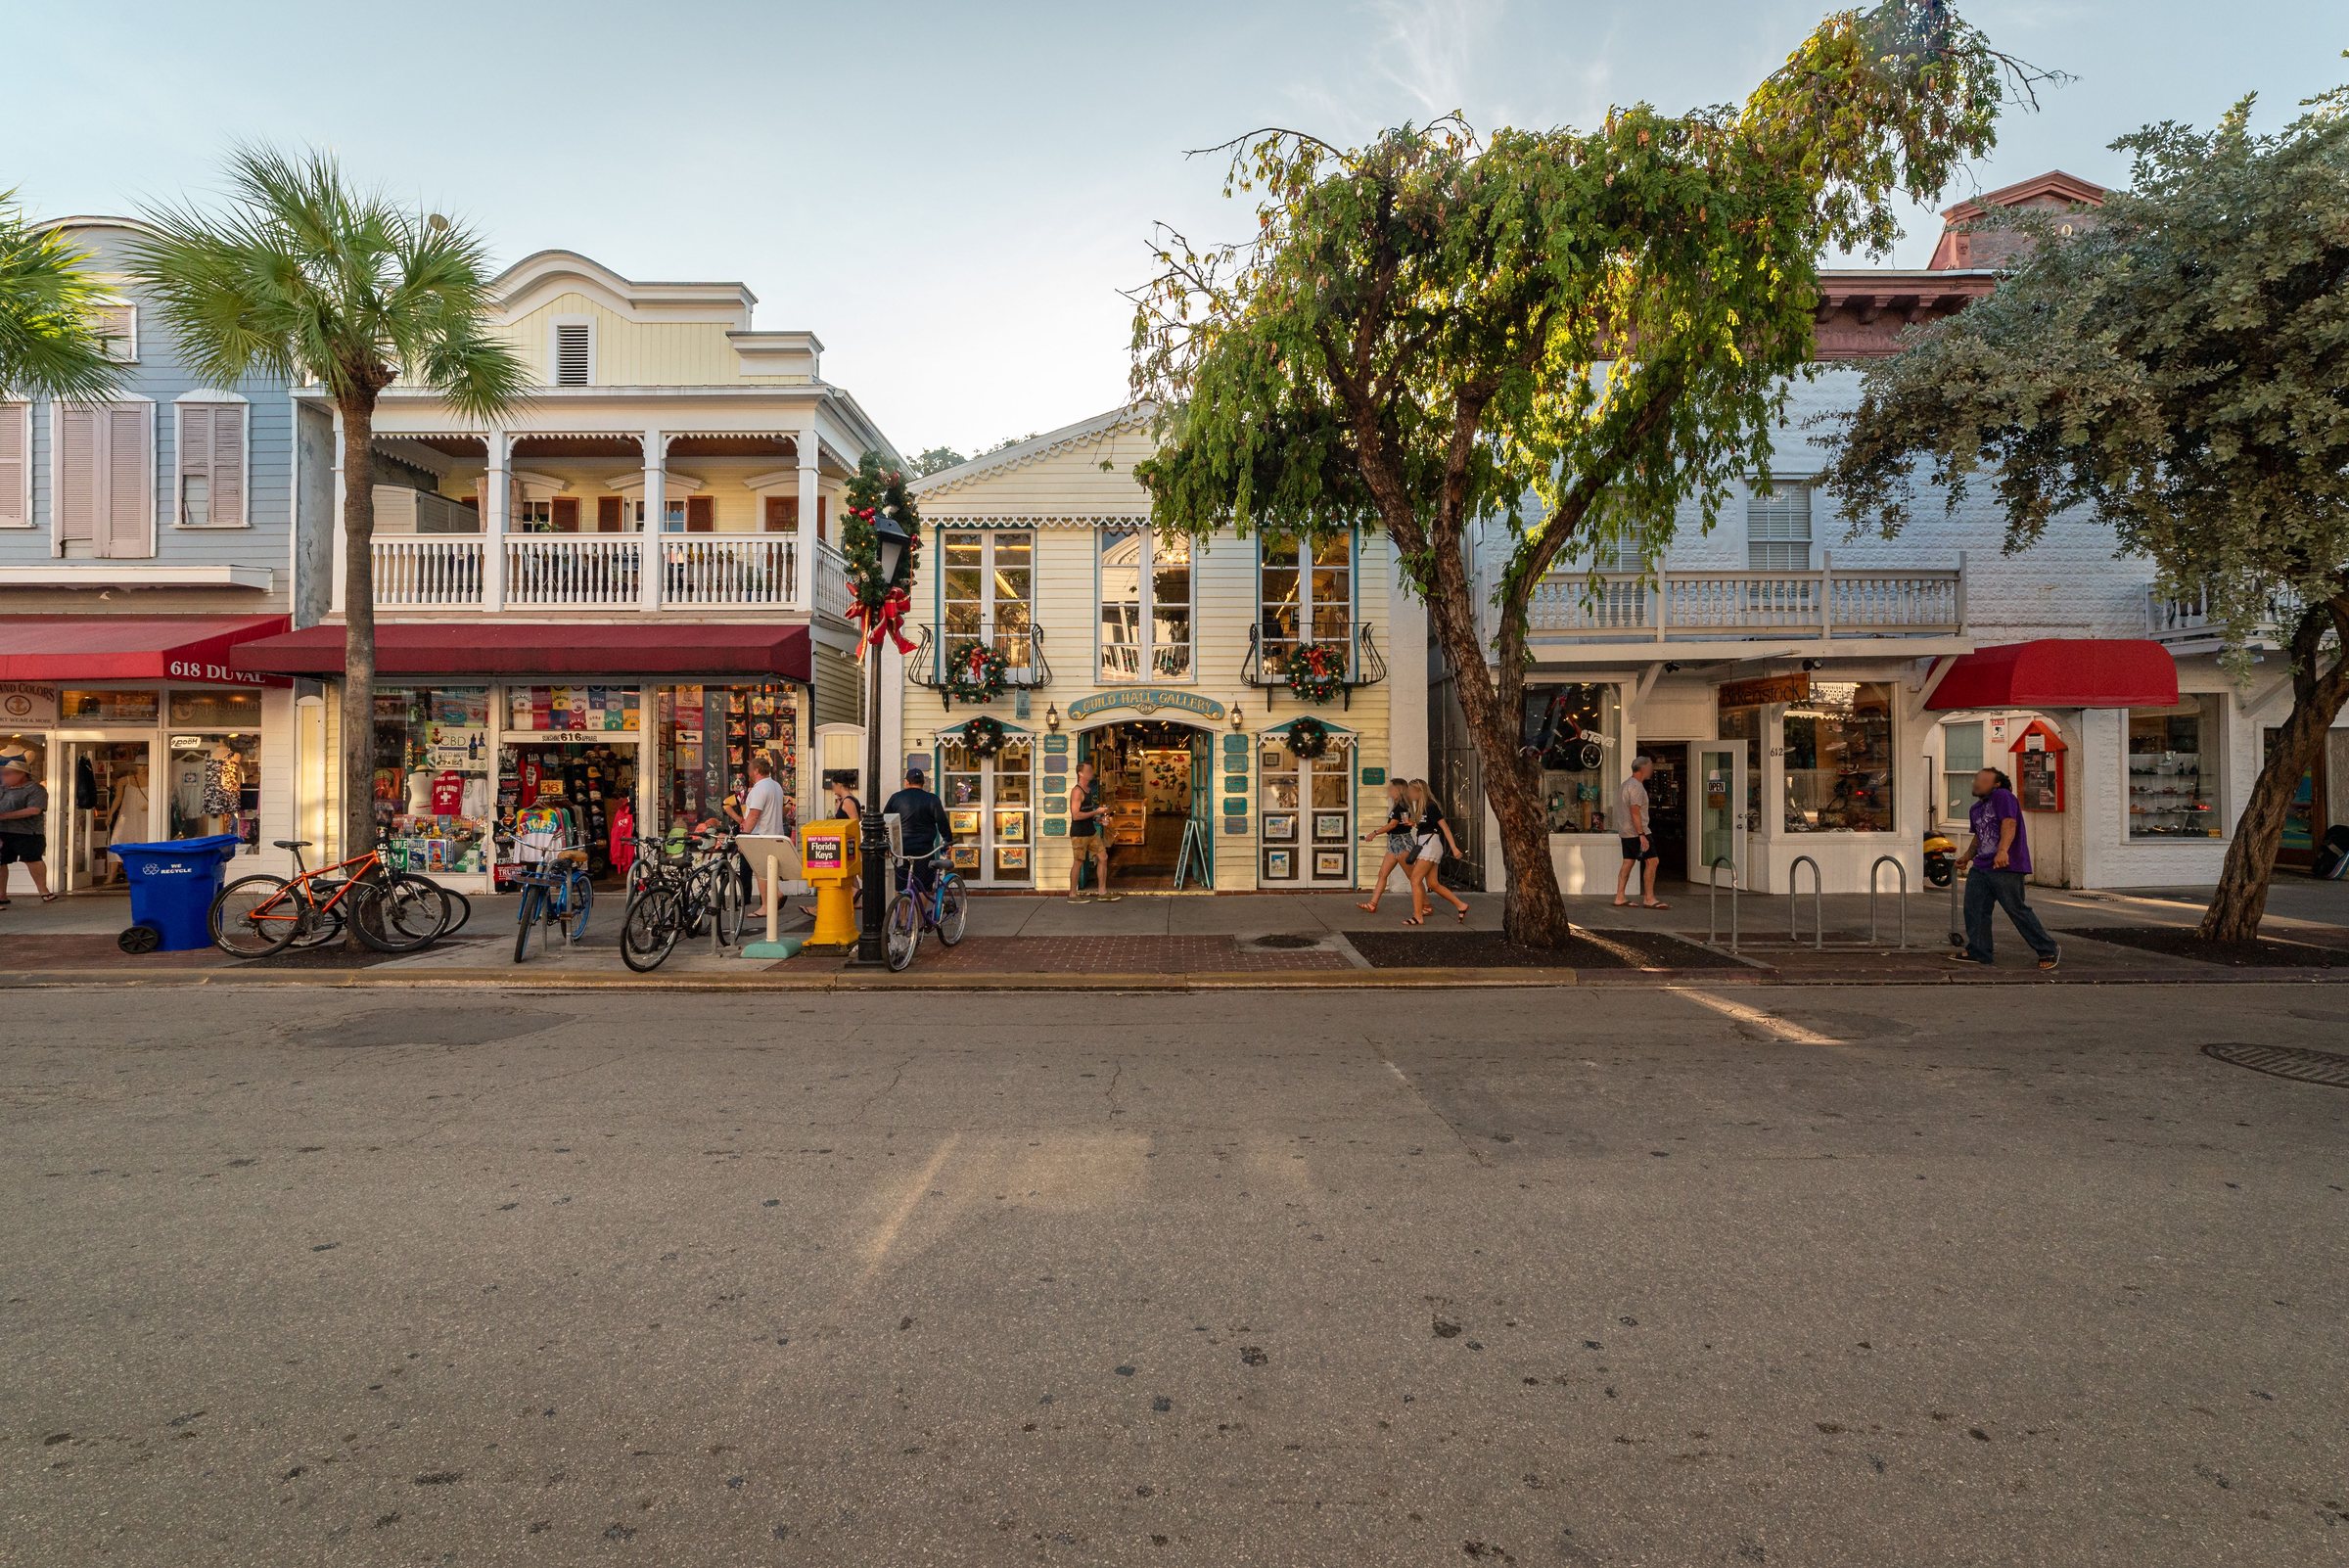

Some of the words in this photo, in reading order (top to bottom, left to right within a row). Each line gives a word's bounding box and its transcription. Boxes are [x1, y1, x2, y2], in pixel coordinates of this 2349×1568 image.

[170, 661, 201, 677] 618
[207, 664, 265, 683] DUVAL
[19, 683, 55, 703] COLORS
[1722, 680, 1806, 707] Birkenstock
[1082, 695, 1116, 712] GUILD
[1121, 692, 1153, 704] HALL
[1159, 692, 1212, 714] GALLERY
[440, 735, 467, 747] CBD
[560, 732, 582, 742] 616
[1588, 729, 1616, 748] Teva
[1771, 747, 1784, 758] 612
[1708, 781, 1725, 792] OPEN
[811, 842, 837, 851] Florida
[815, 851, 833, 860] Keys
